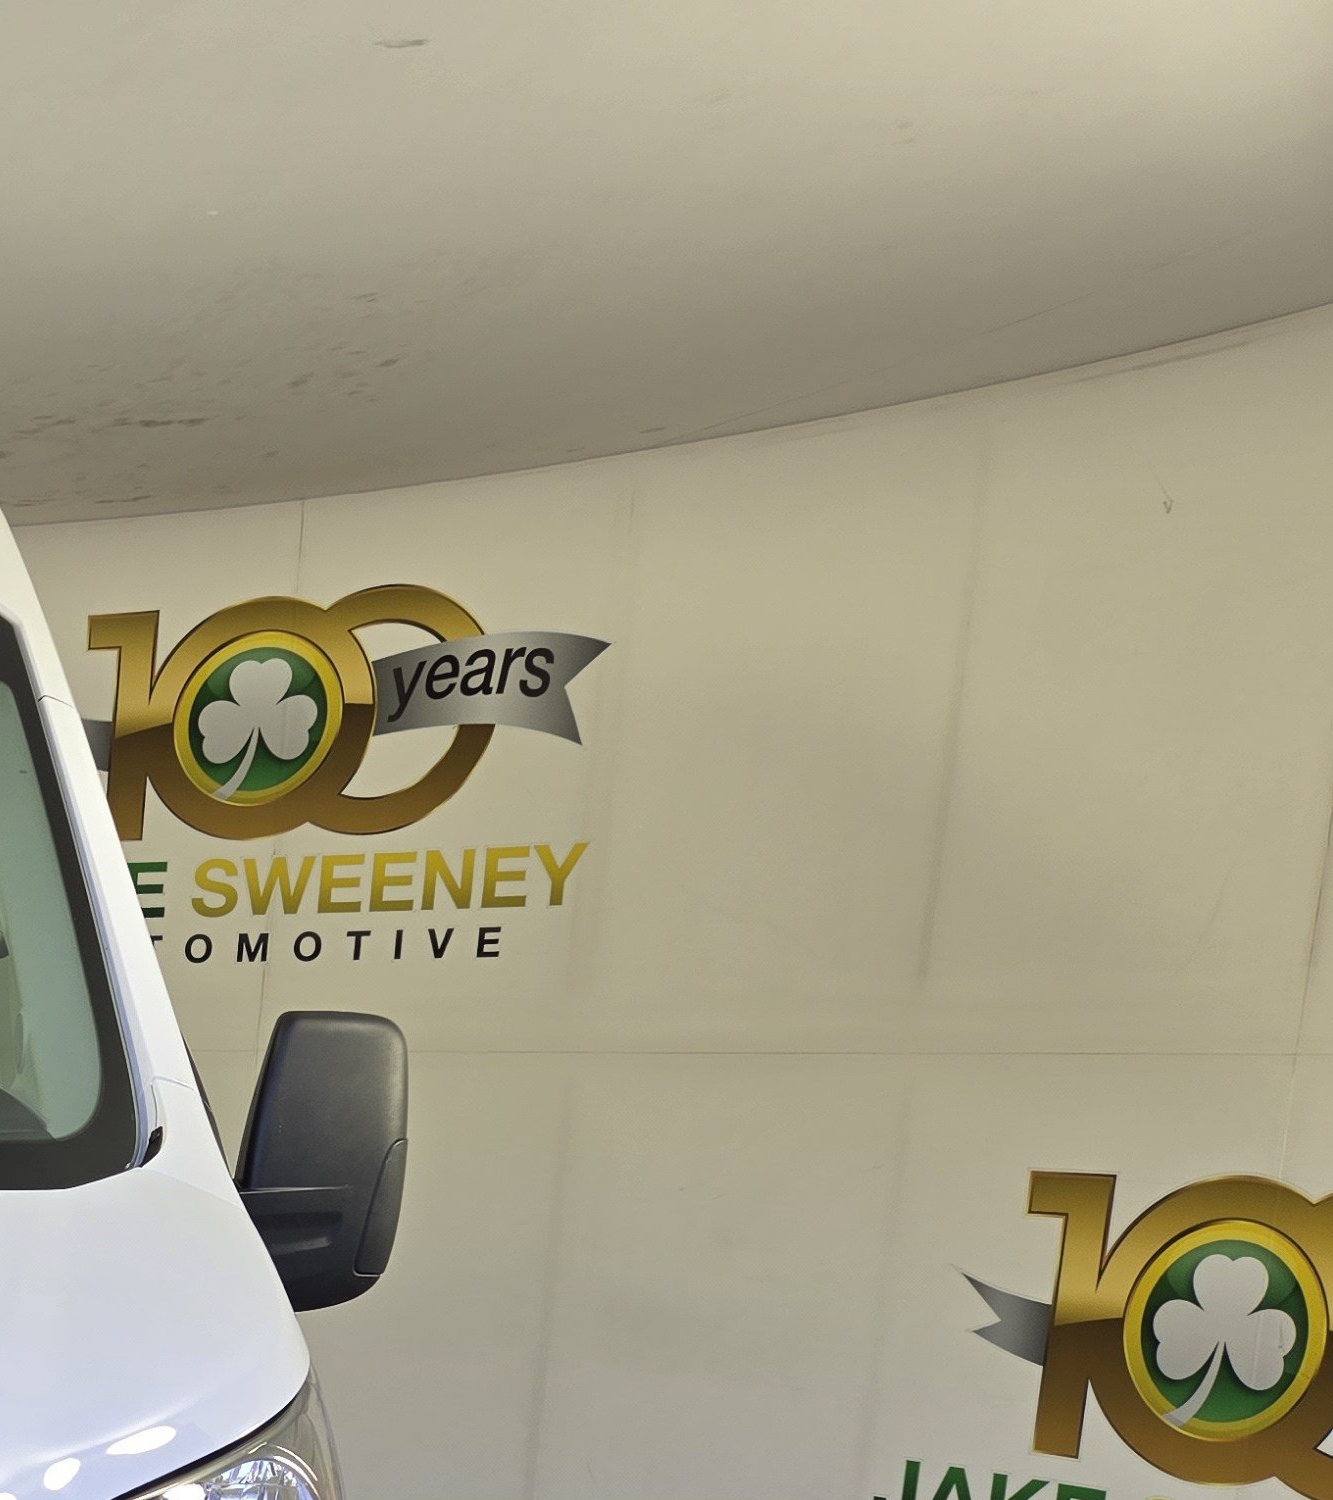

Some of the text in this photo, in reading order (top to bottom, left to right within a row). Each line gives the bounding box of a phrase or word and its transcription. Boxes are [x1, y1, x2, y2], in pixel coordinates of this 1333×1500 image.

[87, 583, 555, 841] 100 years
[191, 841, 591, 917] SWEENEY
